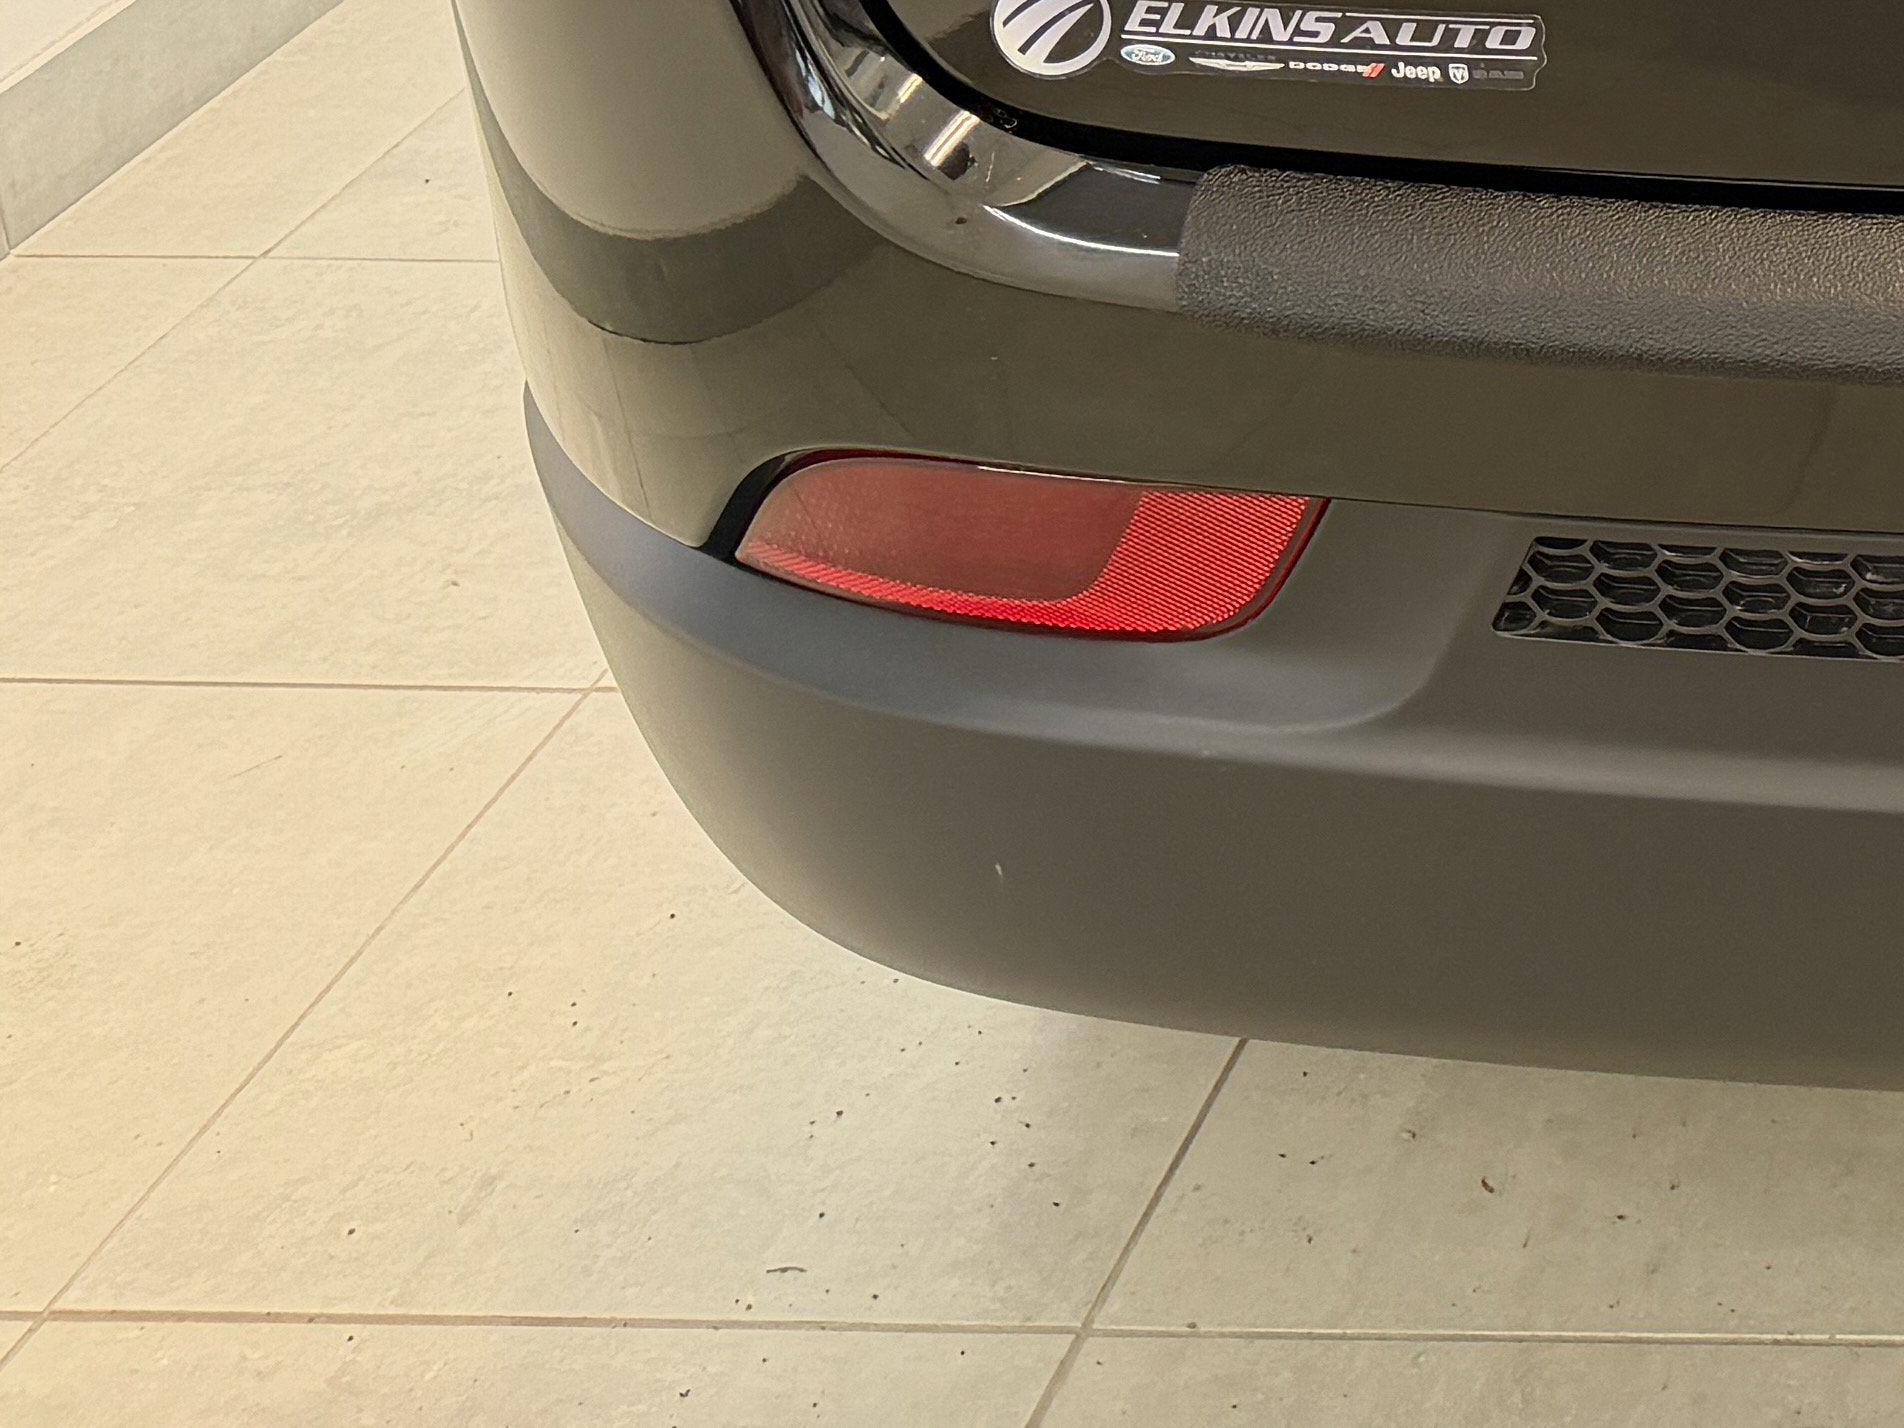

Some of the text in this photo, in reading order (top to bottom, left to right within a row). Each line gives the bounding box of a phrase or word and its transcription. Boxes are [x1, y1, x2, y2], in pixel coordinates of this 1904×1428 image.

[1123, 0, 1537, 50] ELKINS AUTO
[1391, 61, 1442, 83] Jeep
